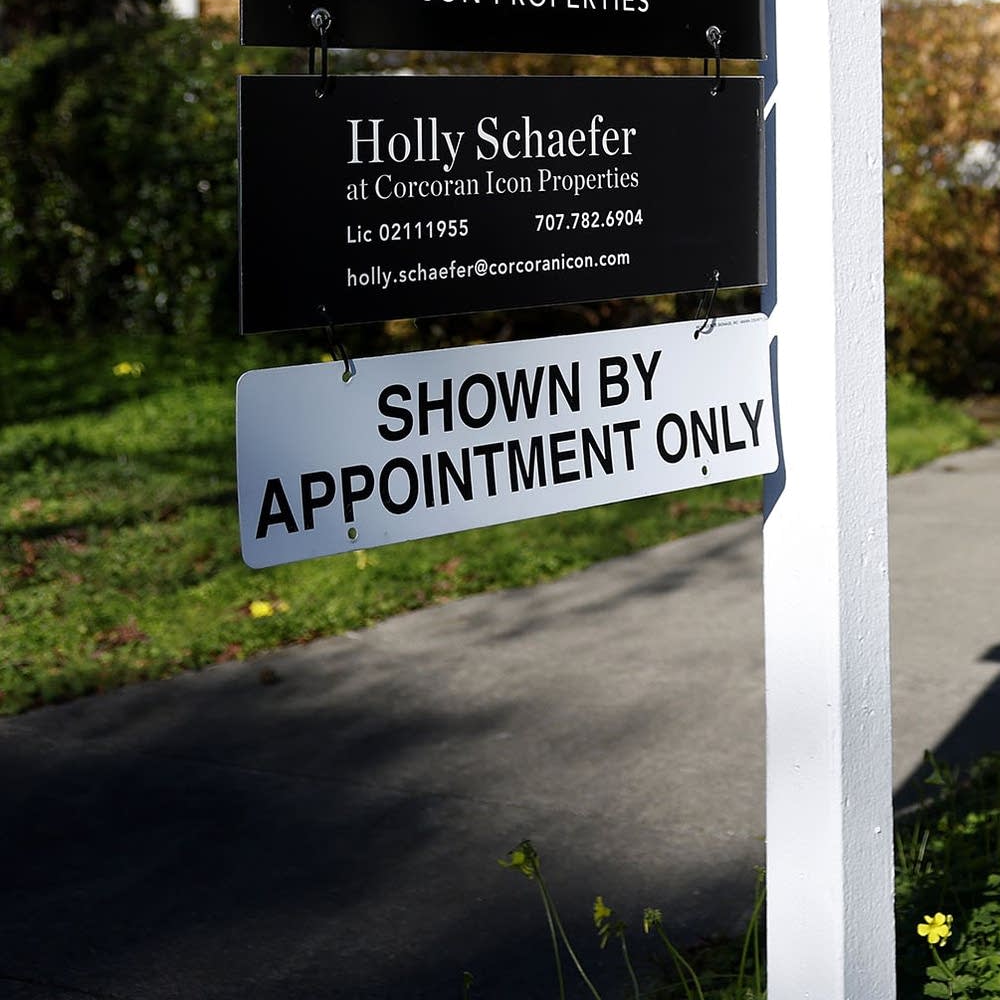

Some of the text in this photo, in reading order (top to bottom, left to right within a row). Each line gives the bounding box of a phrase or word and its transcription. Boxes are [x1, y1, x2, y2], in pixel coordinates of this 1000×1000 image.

[347, 114, 636, 172] Holly Schaefer
[347, 167, 639, 200] at Corcoran Icon Properties
[347, 219, 469, 243] Lic 02111955
[535, 209, 643, 232] 707.782.6904
[347, 252, 630, 289] holly.schaefer@corcoranicon.com
[378, 351, 662, 441] SHOWN BY
[255, 400, 764, 539] APPOINTMENT ONLY
